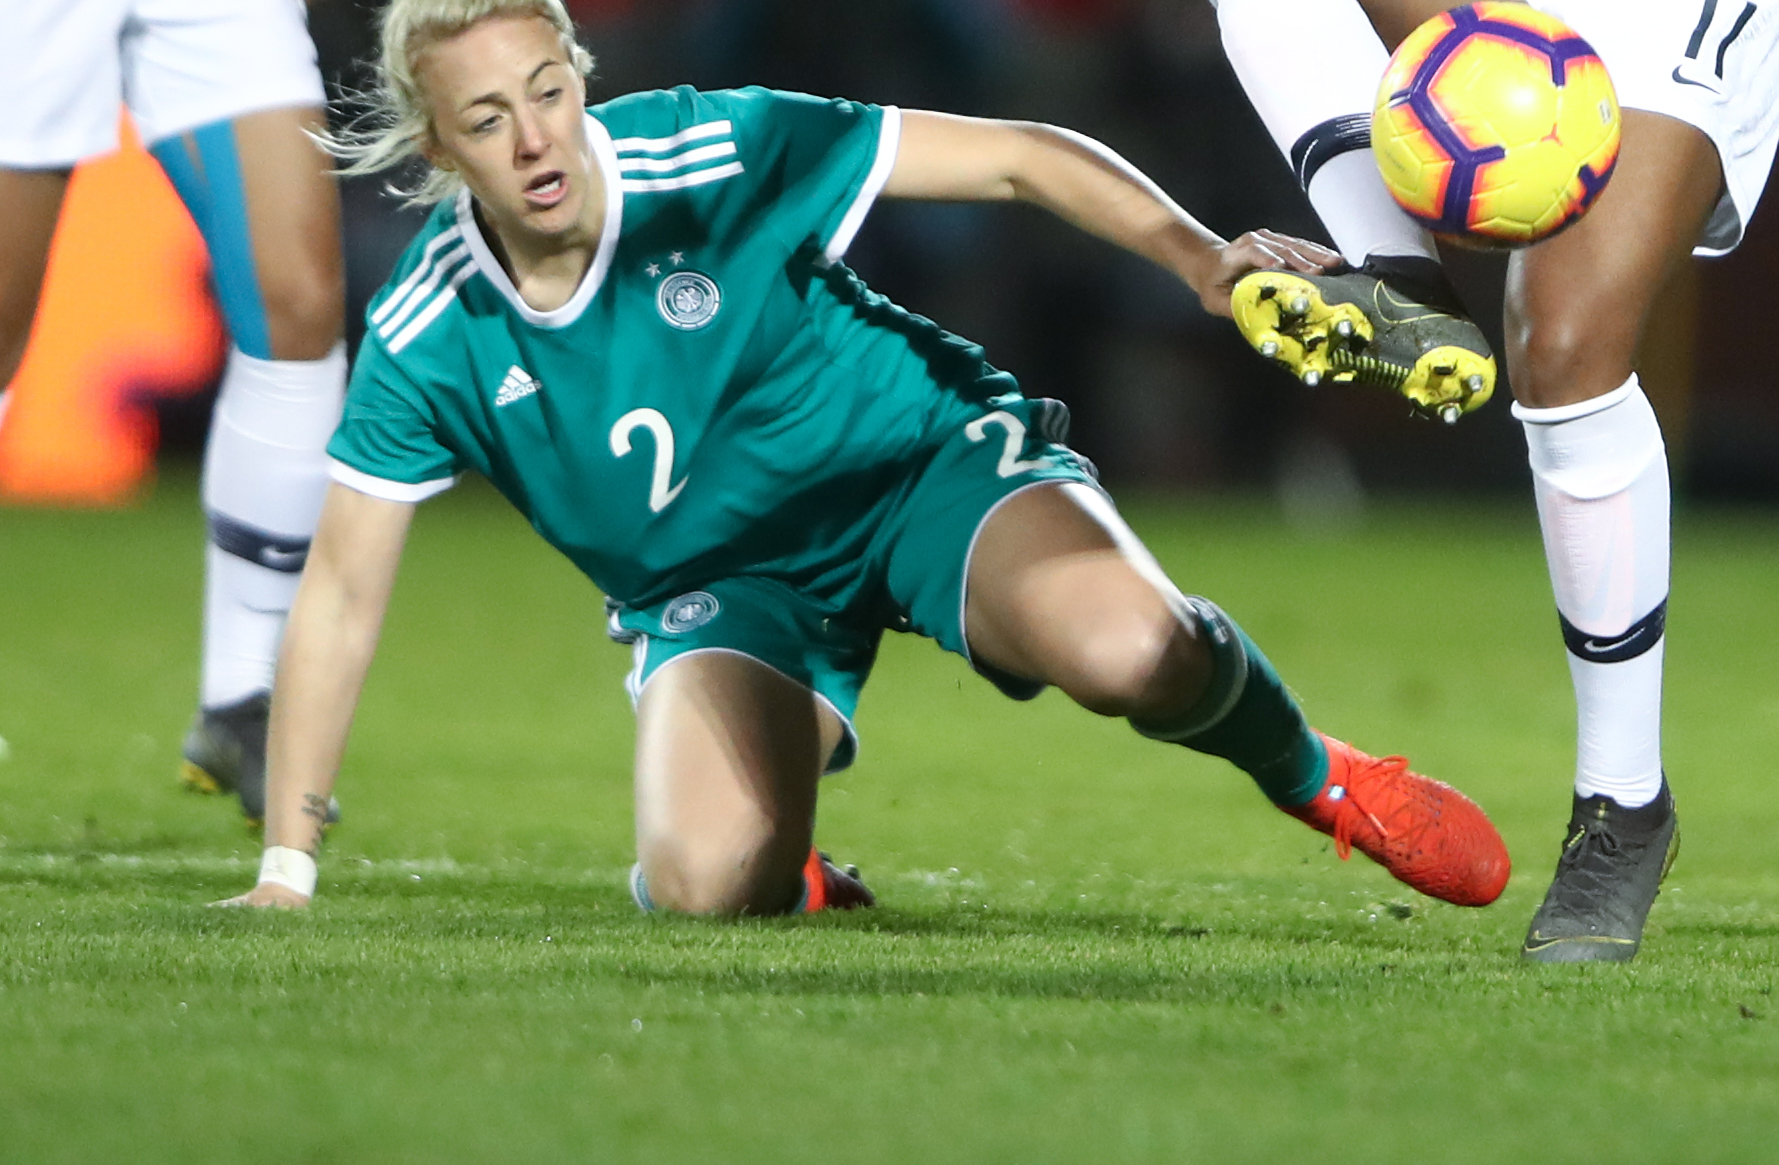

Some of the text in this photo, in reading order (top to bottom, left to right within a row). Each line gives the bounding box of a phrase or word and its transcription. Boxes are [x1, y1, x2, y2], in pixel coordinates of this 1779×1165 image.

[495, 380, 542, 405] adidas
[608, 407, 689, 513] 2
[965, 410, 1055, 478] 2
